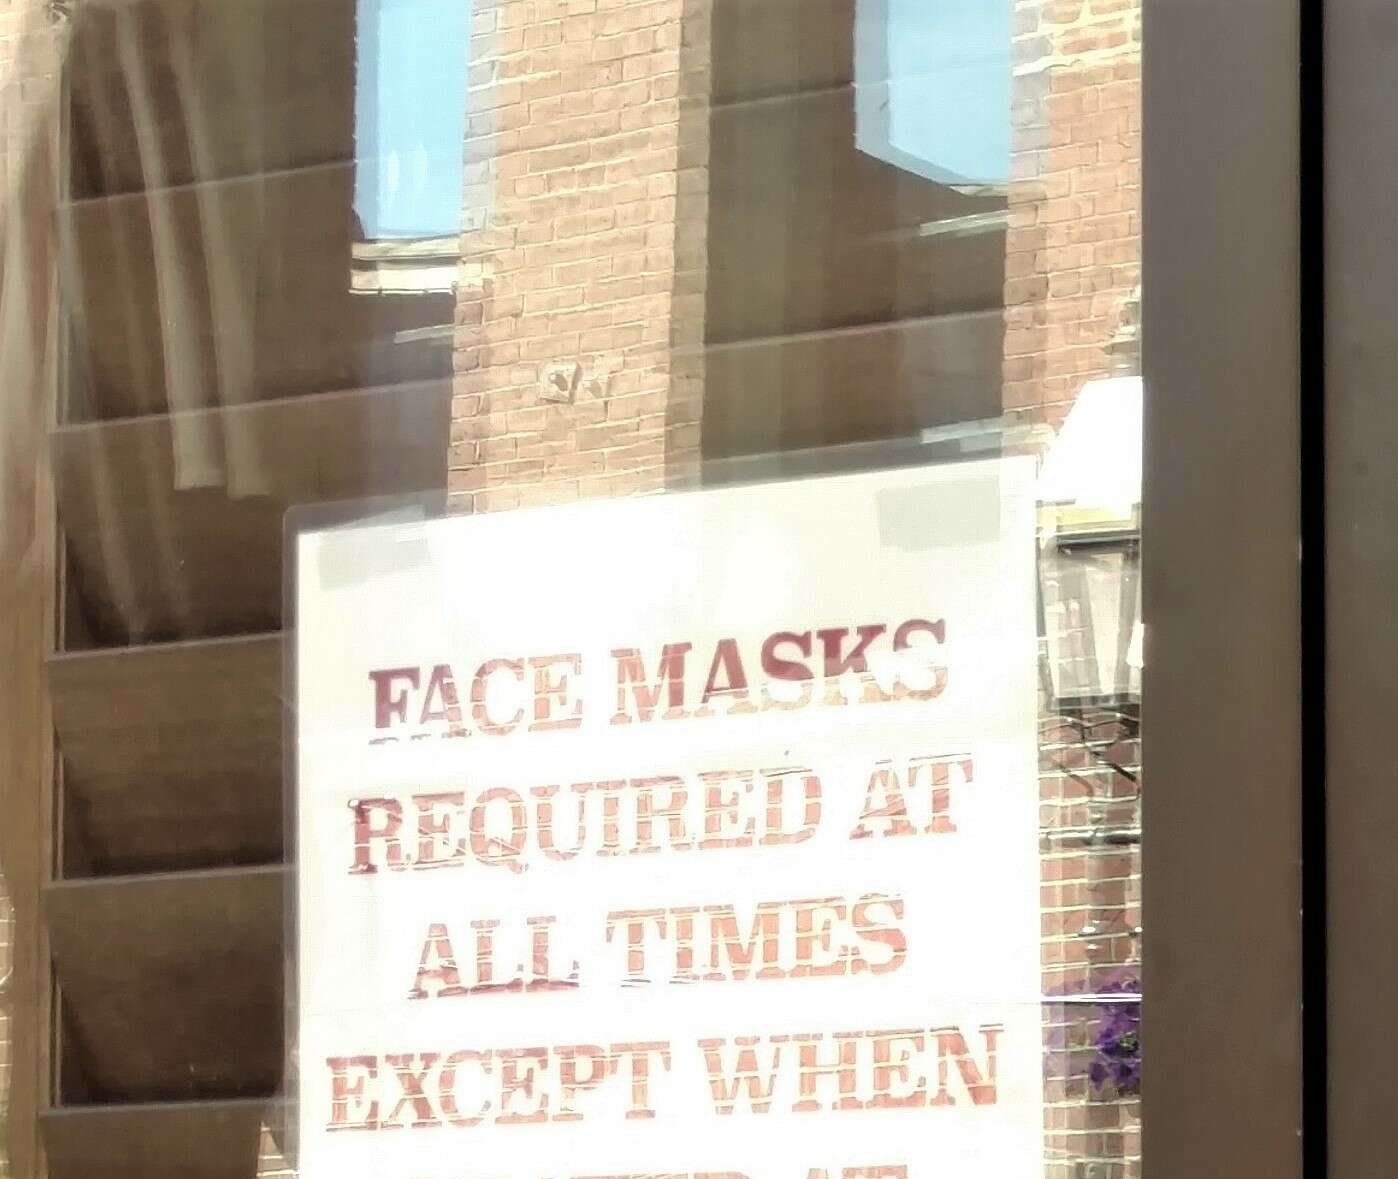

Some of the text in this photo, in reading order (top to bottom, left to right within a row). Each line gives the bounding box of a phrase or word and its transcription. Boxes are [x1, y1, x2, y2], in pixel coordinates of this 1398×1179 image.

[367, 618, 948, 746] FACE MASKS
[346, 752, 974, 876] REQUIRED AT
[406, 892, 907, 1000] ALL TIMES
[324, 1023, 1005, 1133] EXCEPT WHEN
